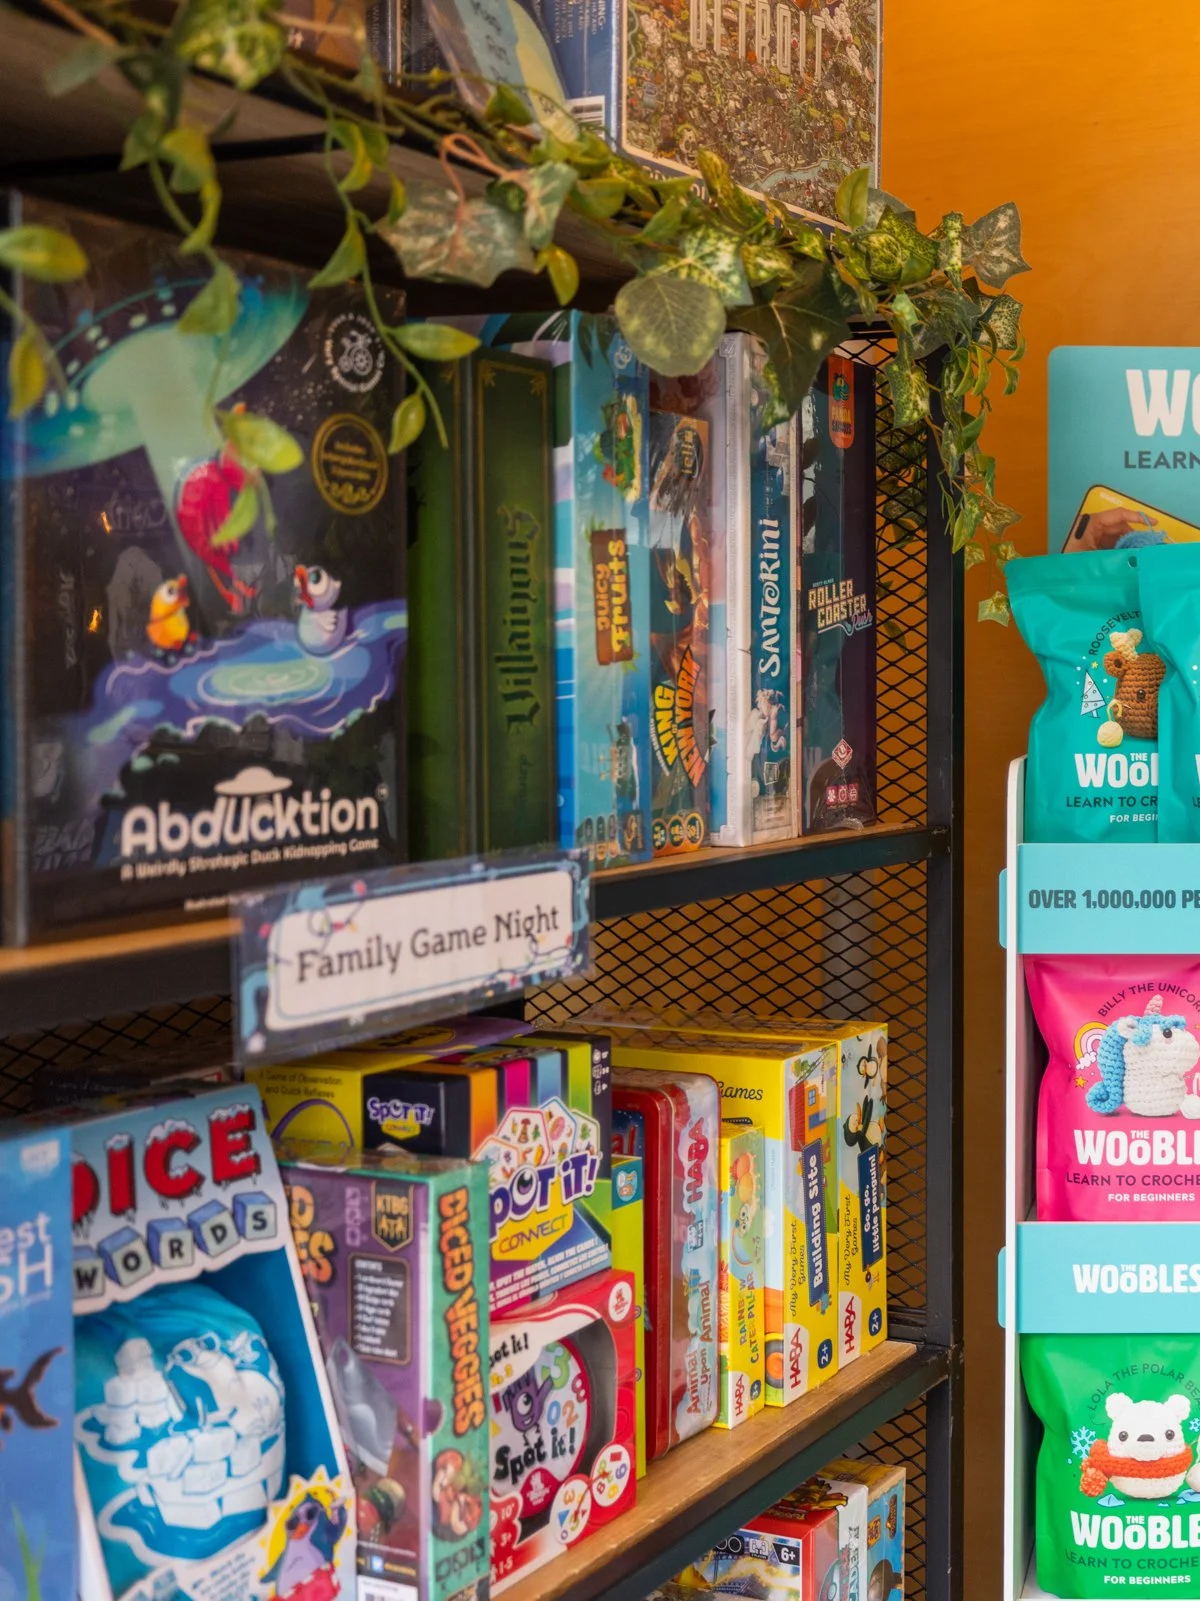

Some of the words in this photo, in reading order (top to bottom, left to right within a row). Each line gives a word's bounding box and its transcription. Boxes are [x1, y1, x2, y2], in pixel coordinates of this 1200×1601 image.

[808, 579, 853, 611] ROLLER
[817, 593, 867, 629] COASTER
[675, 649, 700, 724] YORK
[653, 684, 679, 767] KING
[675, 726, 706, 788] NEW
[1066, 796, 1114, 808] LEARN
[1118, 796, 1137, 808] TO
[1028, 889, 1076, 909] OVER
[1082, 889, 1176, 911] 1,000,000
[296, 934, 404, 984] Family
[410, 927, 488, 960] Game
[494, 903, 561, 943] Night
[1097, 990, 1127, 1018] BILLY
[1129, 982, 1155, 995] THE
[685, 1116, 710, 1205] HABA
[807, 1155, 820, 1199] Site
[1066, 1172, 1111, 1186] LEARN
[1116, 1174, 1137, 1186] TO
[868, 1154, 881, 1212] penguin!
[1107, 1192, 1131, 1202] FOR
[1133, 1192, 1195, 1202] BEGINNERS
[73, 1210, 269, 1291] WORDS
[439, 1185, 474, 1293] DICED
[499, 1213, 568, 1254] CONNECT
[809, 1202, 824, 1288] Building
[843, 1227, 852, 1260] Very
[851, 1217, 859, 1256] Games
[870, 1214, 881, 1252] little
[788, 1257, 799, 1291] Very
[798, 1245, 806, 1286] Games
[1120, 1263, 1137, 1273] THE
[698, 1279, 714, 1344] Animal
[788, 1291, 799, 1318] My
[844, 1295, 856, 1354] HABA
[871, 1312, 880, 1334] 2+
[443, 1286, 487, 1437] VEGGIES
[788, 1327, 803, 1389] HABA
[820, 1343, 830, 1365] 2+
[735, 1372, 745, 1417] HABA
[1089, 1381, 1114, 1412] LOLA
[1113, 1364, 1139, 1381] THE
[1142, 1363, 1185, 1384] POLAR
[493, 1437, 547, 1486] Spot
[551, 1427, 576, 1459] it!
[781, 1546, 796, 1561] 6+
[1104, 1575, 1126, 1585] FOR
[1129, 1574, 1192, 1585] BEGINNERS
